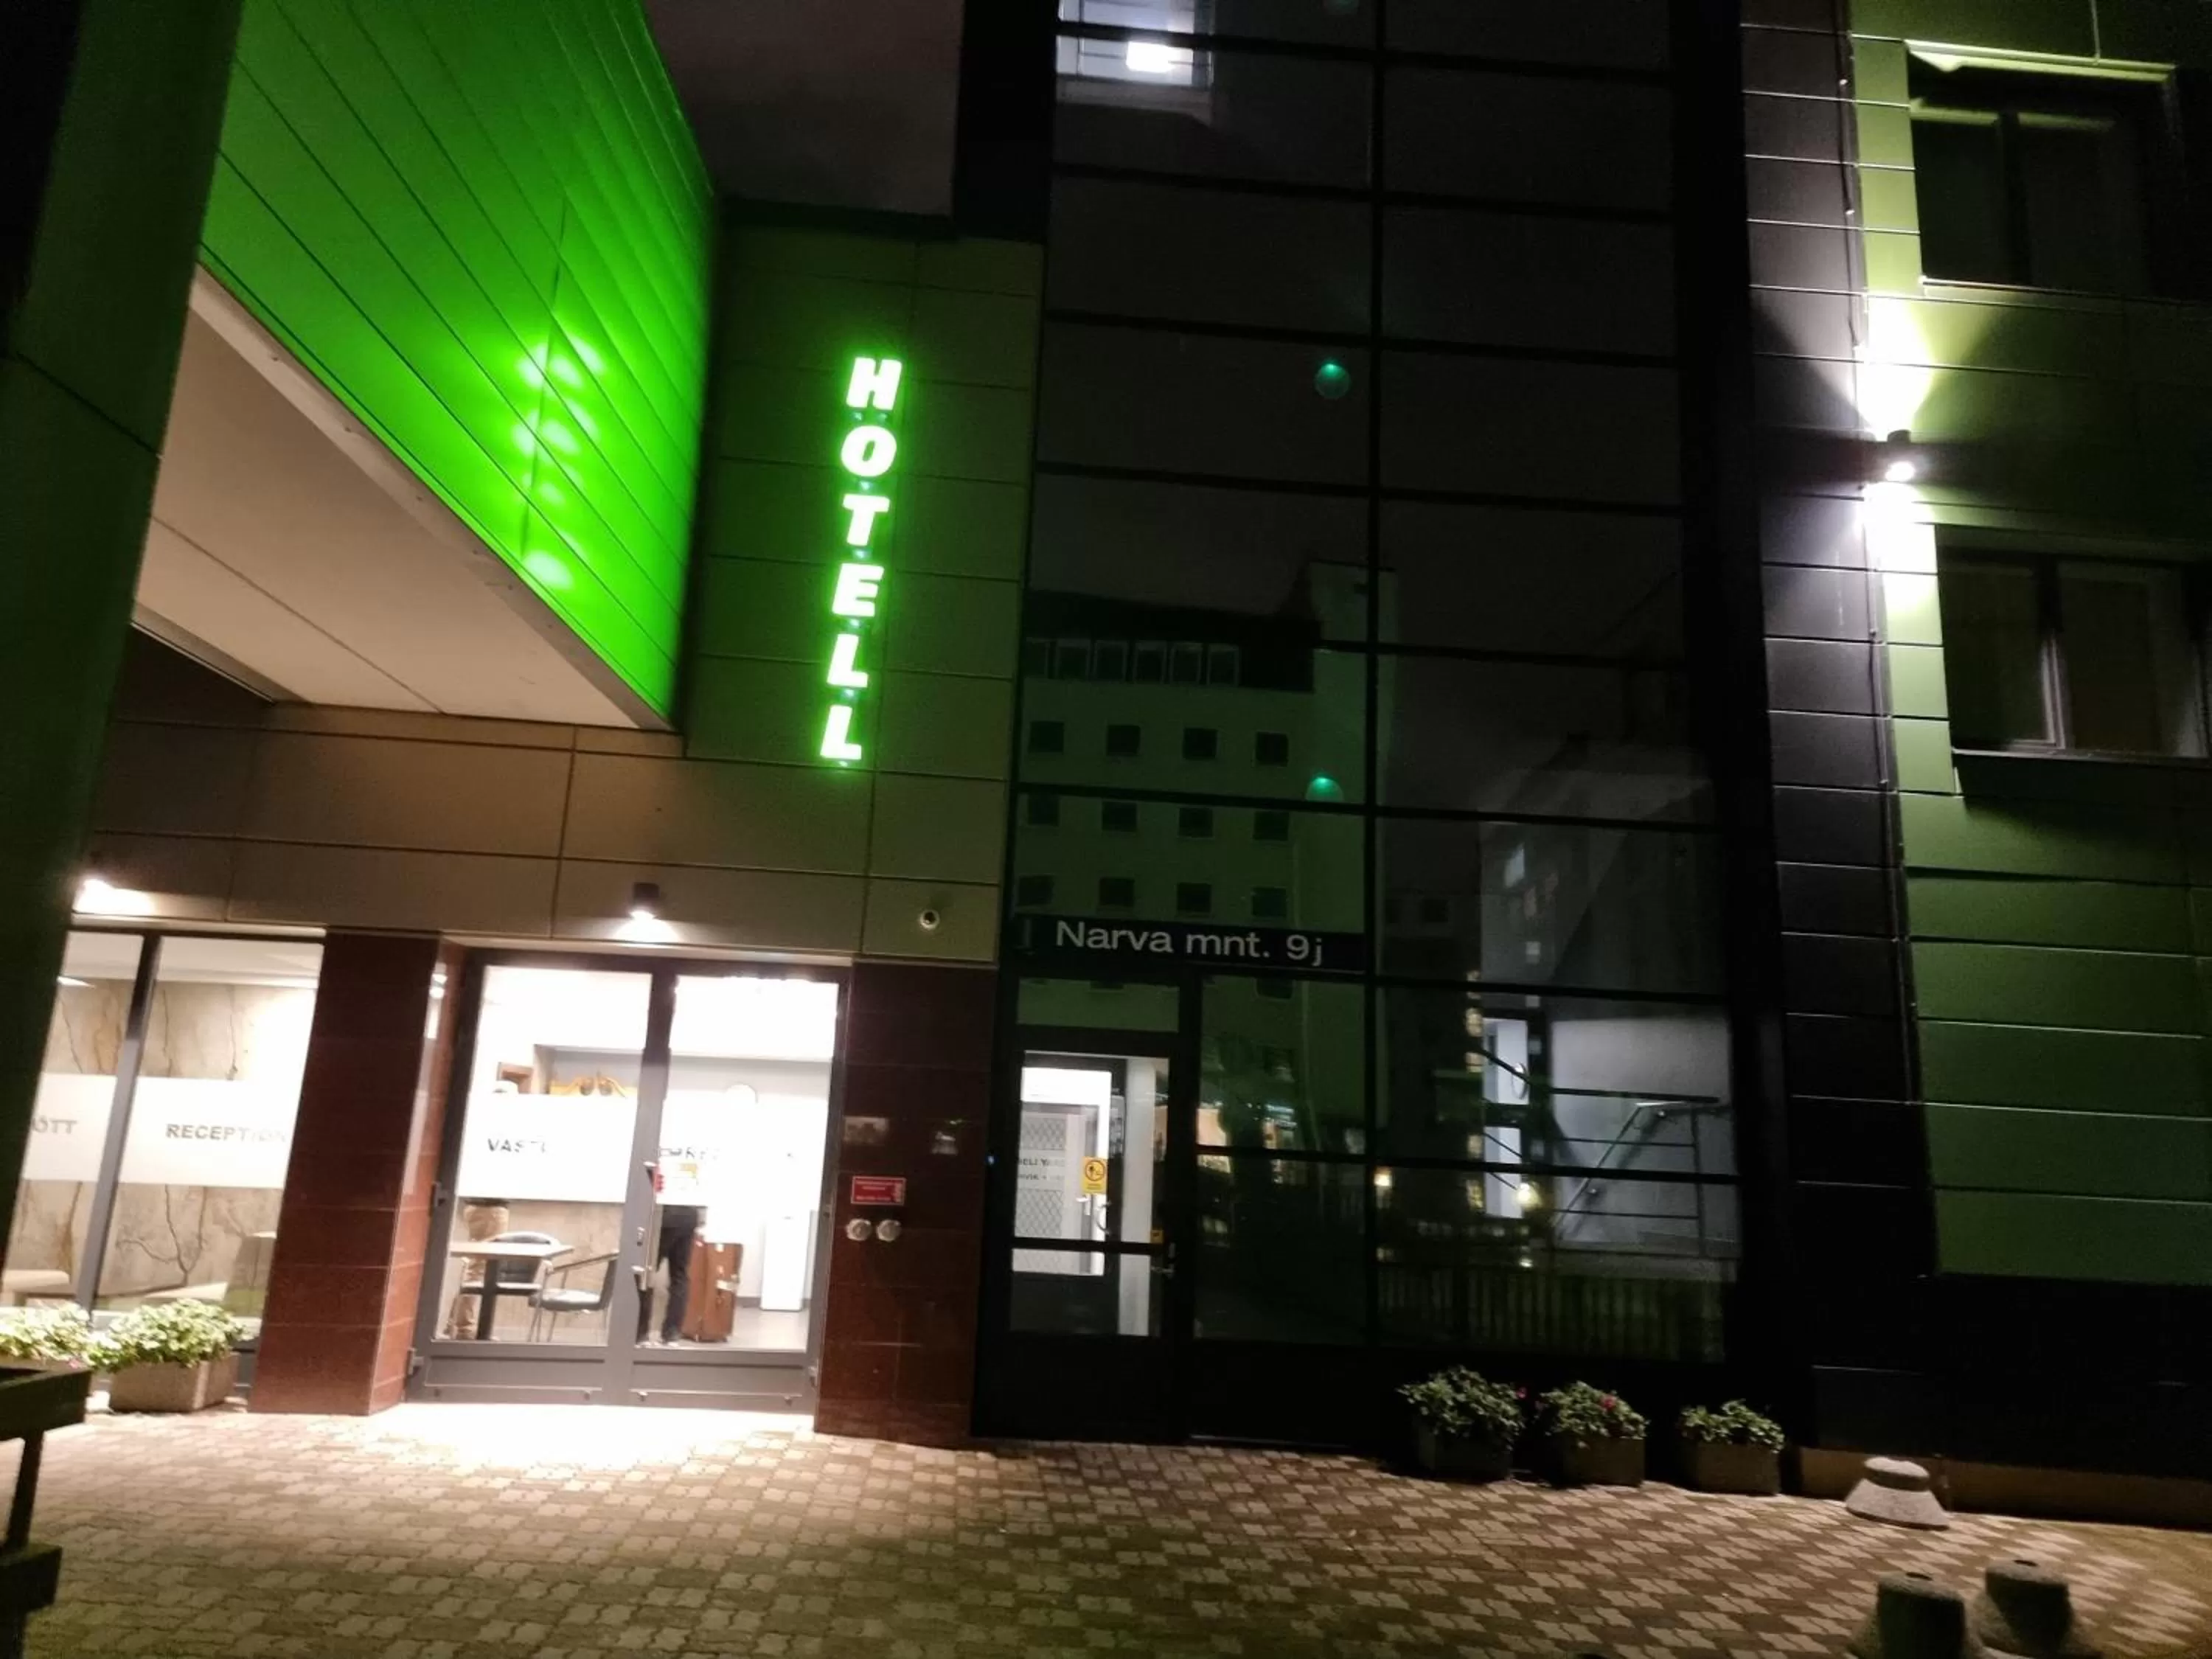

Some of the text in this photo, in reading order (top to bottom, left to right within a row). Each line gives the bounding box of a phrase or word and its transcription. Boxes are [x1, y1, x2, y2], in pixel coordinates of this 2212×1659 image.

[819, 357, 902, 761] HOTELL
[1055, 919, 1323, 967] Narva mnt. 9j
